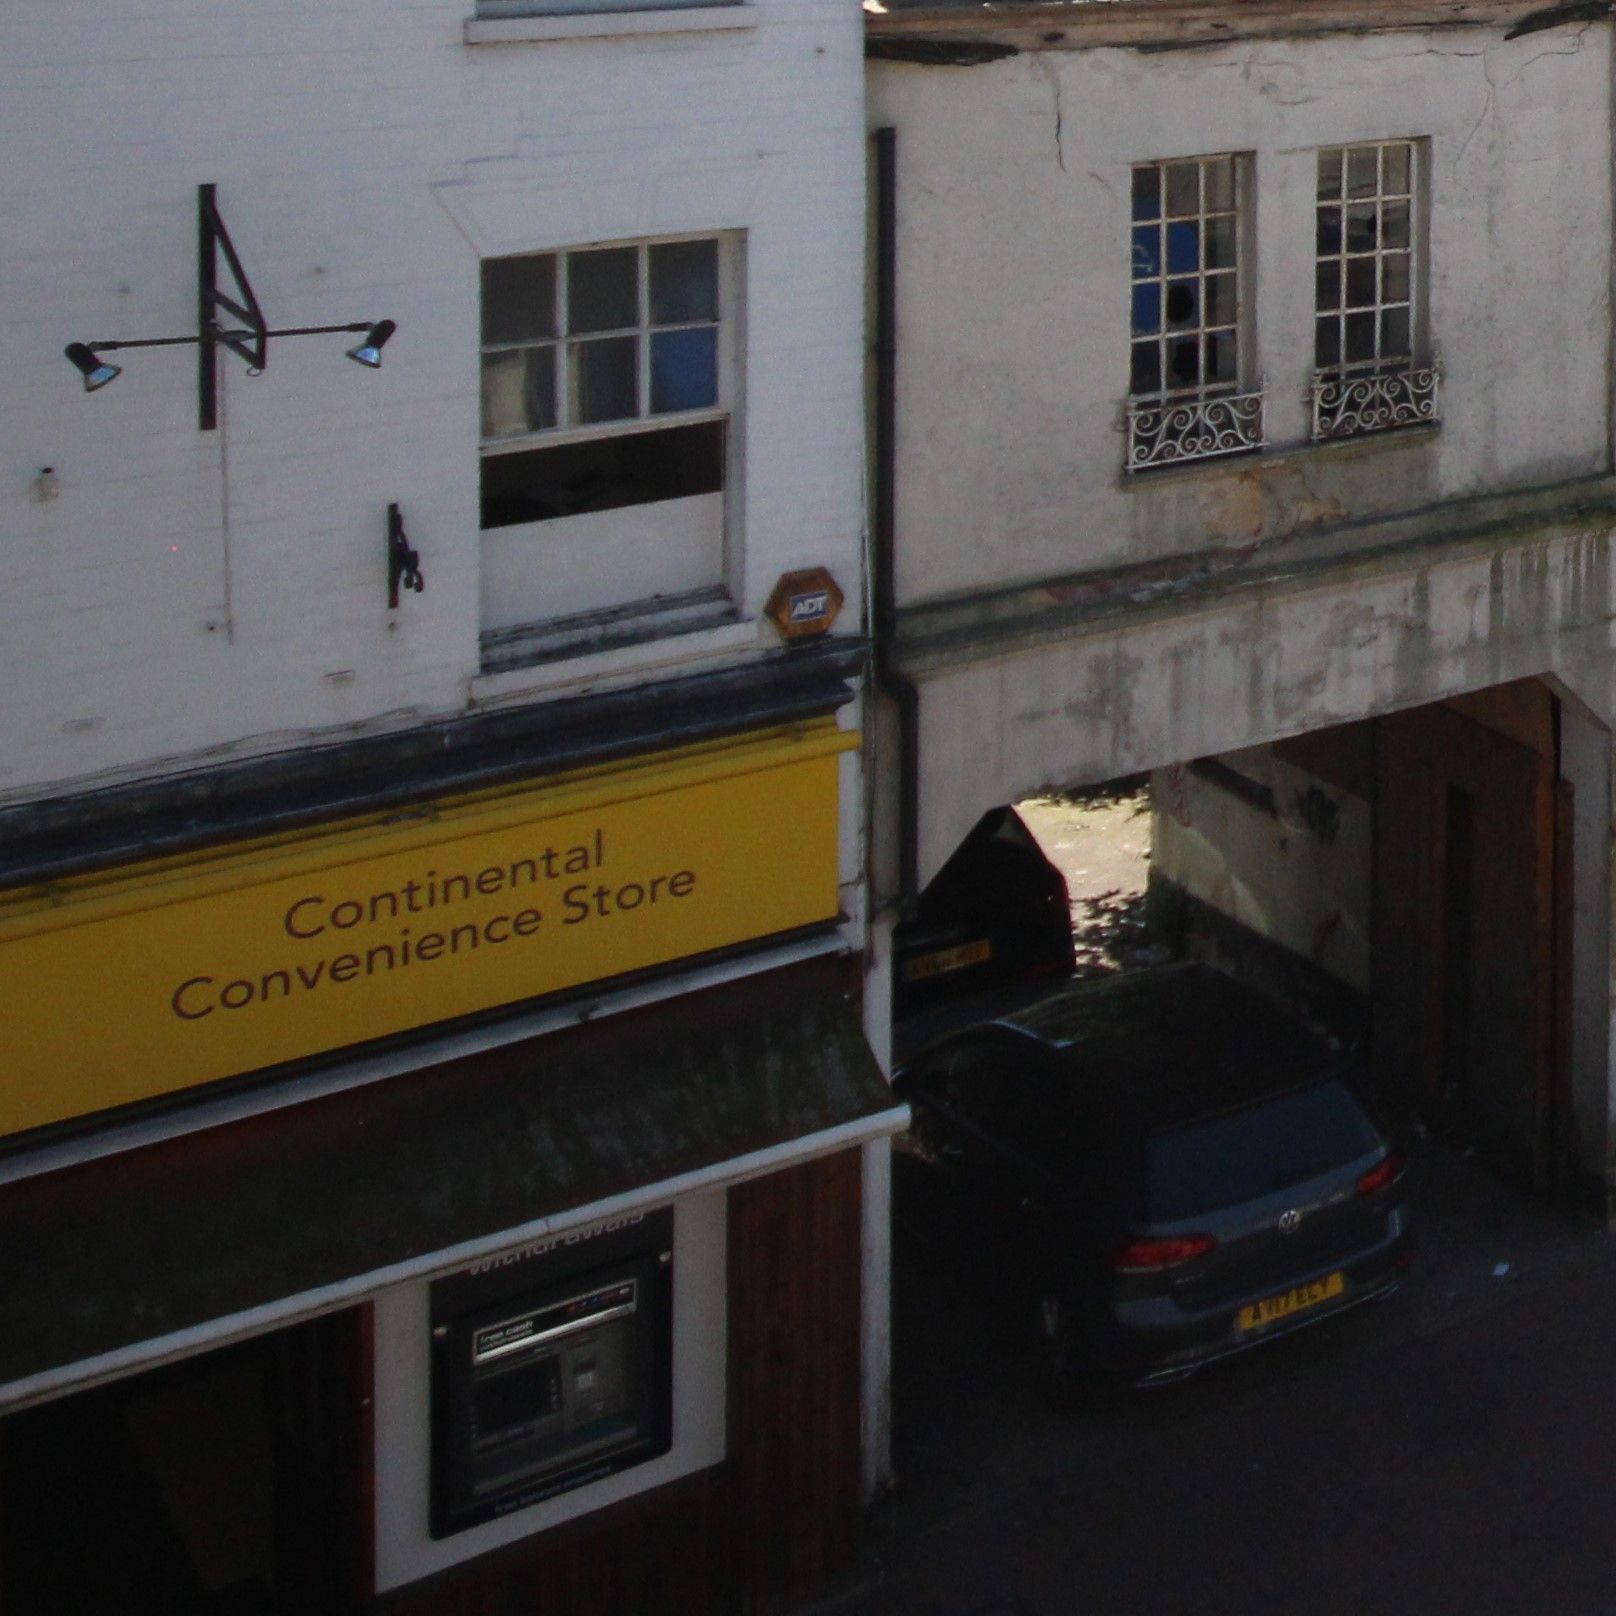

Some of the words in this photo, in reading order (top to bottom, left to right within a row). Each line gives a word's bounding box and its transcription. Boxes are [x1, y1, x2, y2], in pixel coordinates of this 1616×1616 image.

[791, 594, 827, 618] ADT
[285, 829, 602, 939] Continental
[171, 907, 543, 1020] Convenience
[562, 869, 696, 925] Store
